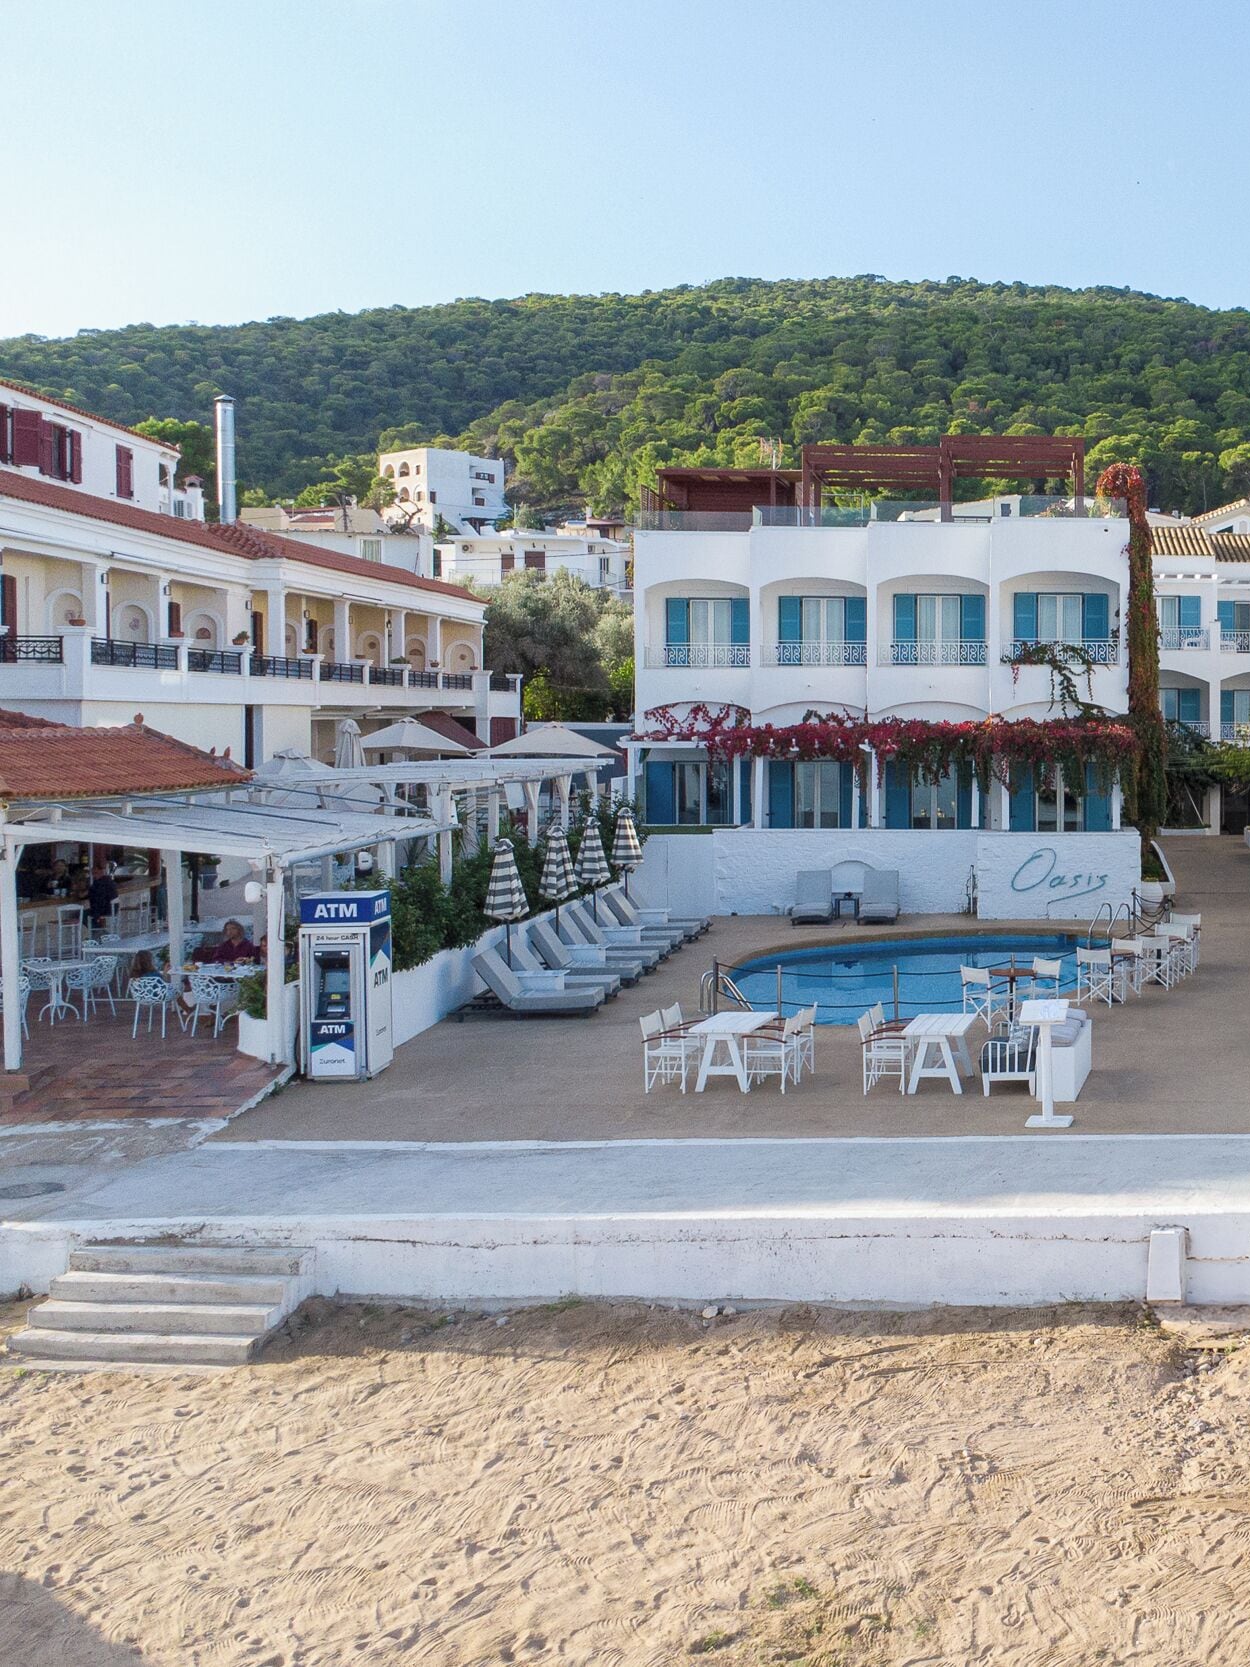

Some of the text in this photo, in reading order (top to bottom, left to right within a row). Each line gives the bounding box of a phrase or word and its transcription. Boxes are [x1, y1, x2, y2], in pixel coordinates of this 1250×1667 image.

[1011, 847, 1108, 904] Oasis
[314, 903, 357, 918] ATM
[374, 897, 387, 915] ATM
[373, 968, 388, 988] ATM
[320, 1024, 346, 1034] ATM
